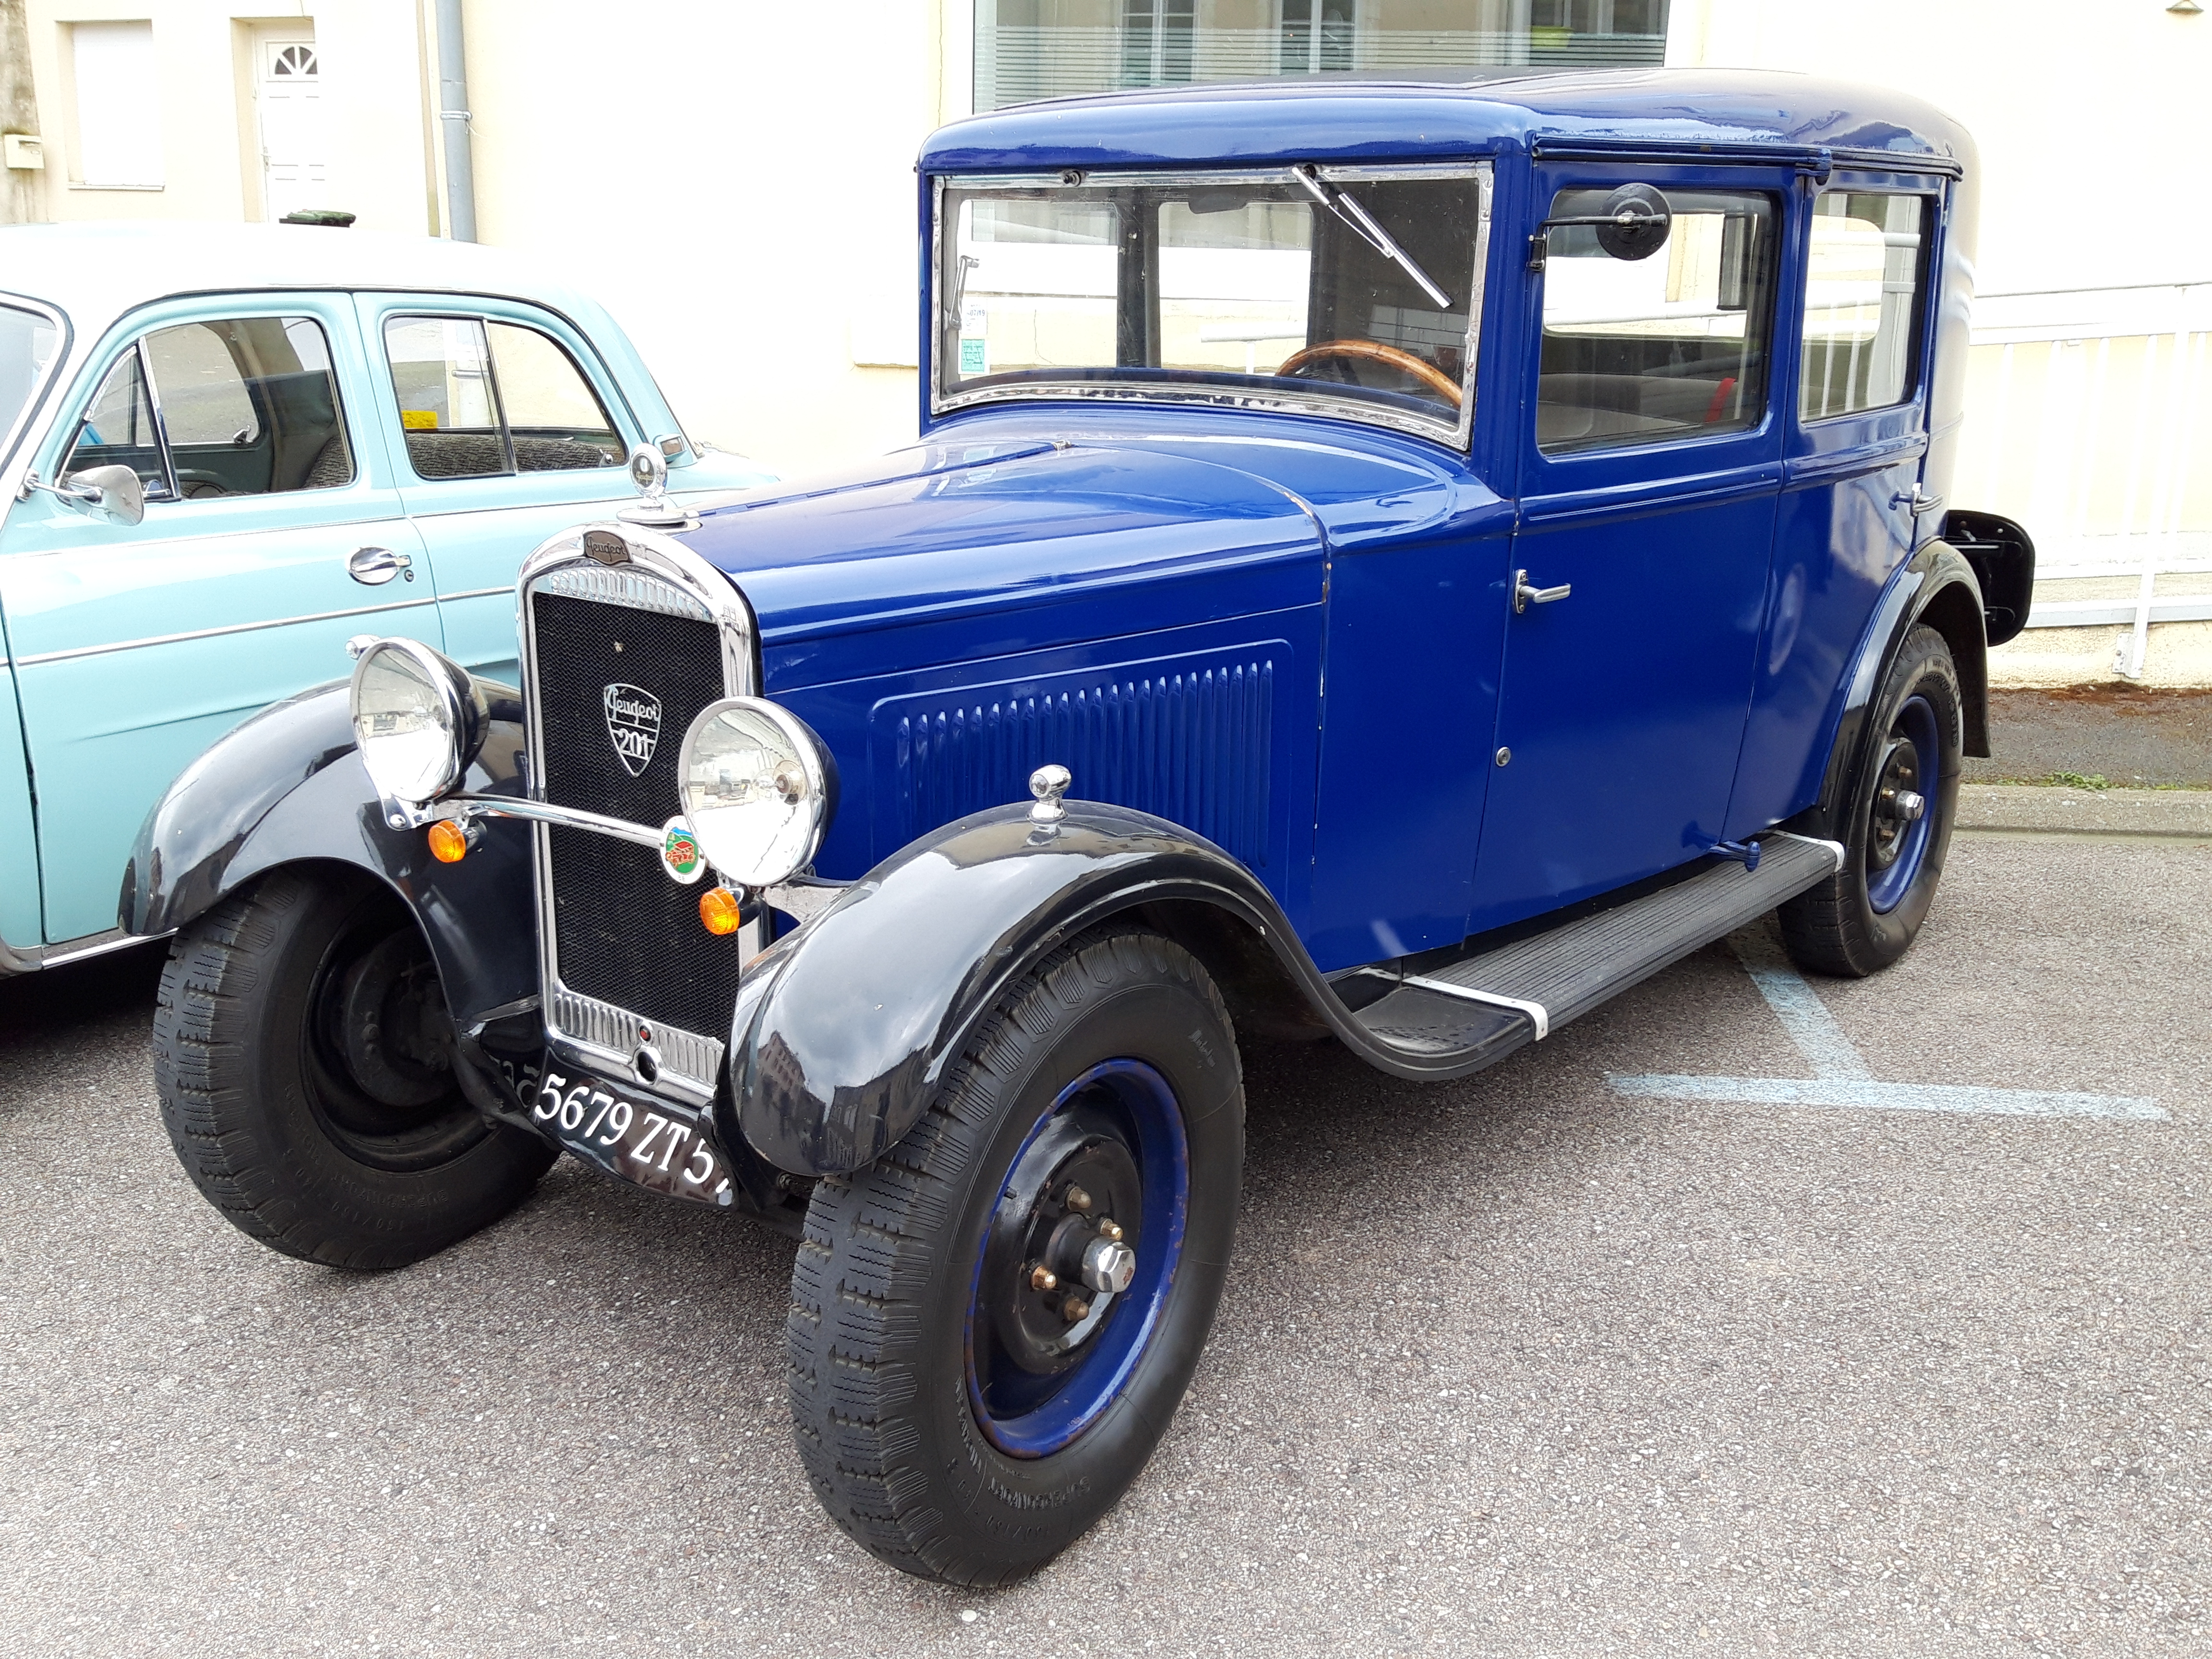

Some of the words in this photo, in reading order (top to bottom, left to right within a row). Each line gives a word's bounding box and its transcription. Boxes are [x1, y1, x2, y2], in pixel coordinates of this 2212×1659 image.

[586, 535, 626, 562] Peugeot
[606, 685, 661, 725] Peugeot
[618, 728, 649, 760] 201
[534, 1073, 634, 1146] 5679
[630, 1112, 691, 1172] ZT
[683, 1138, 729, 1194] 5
